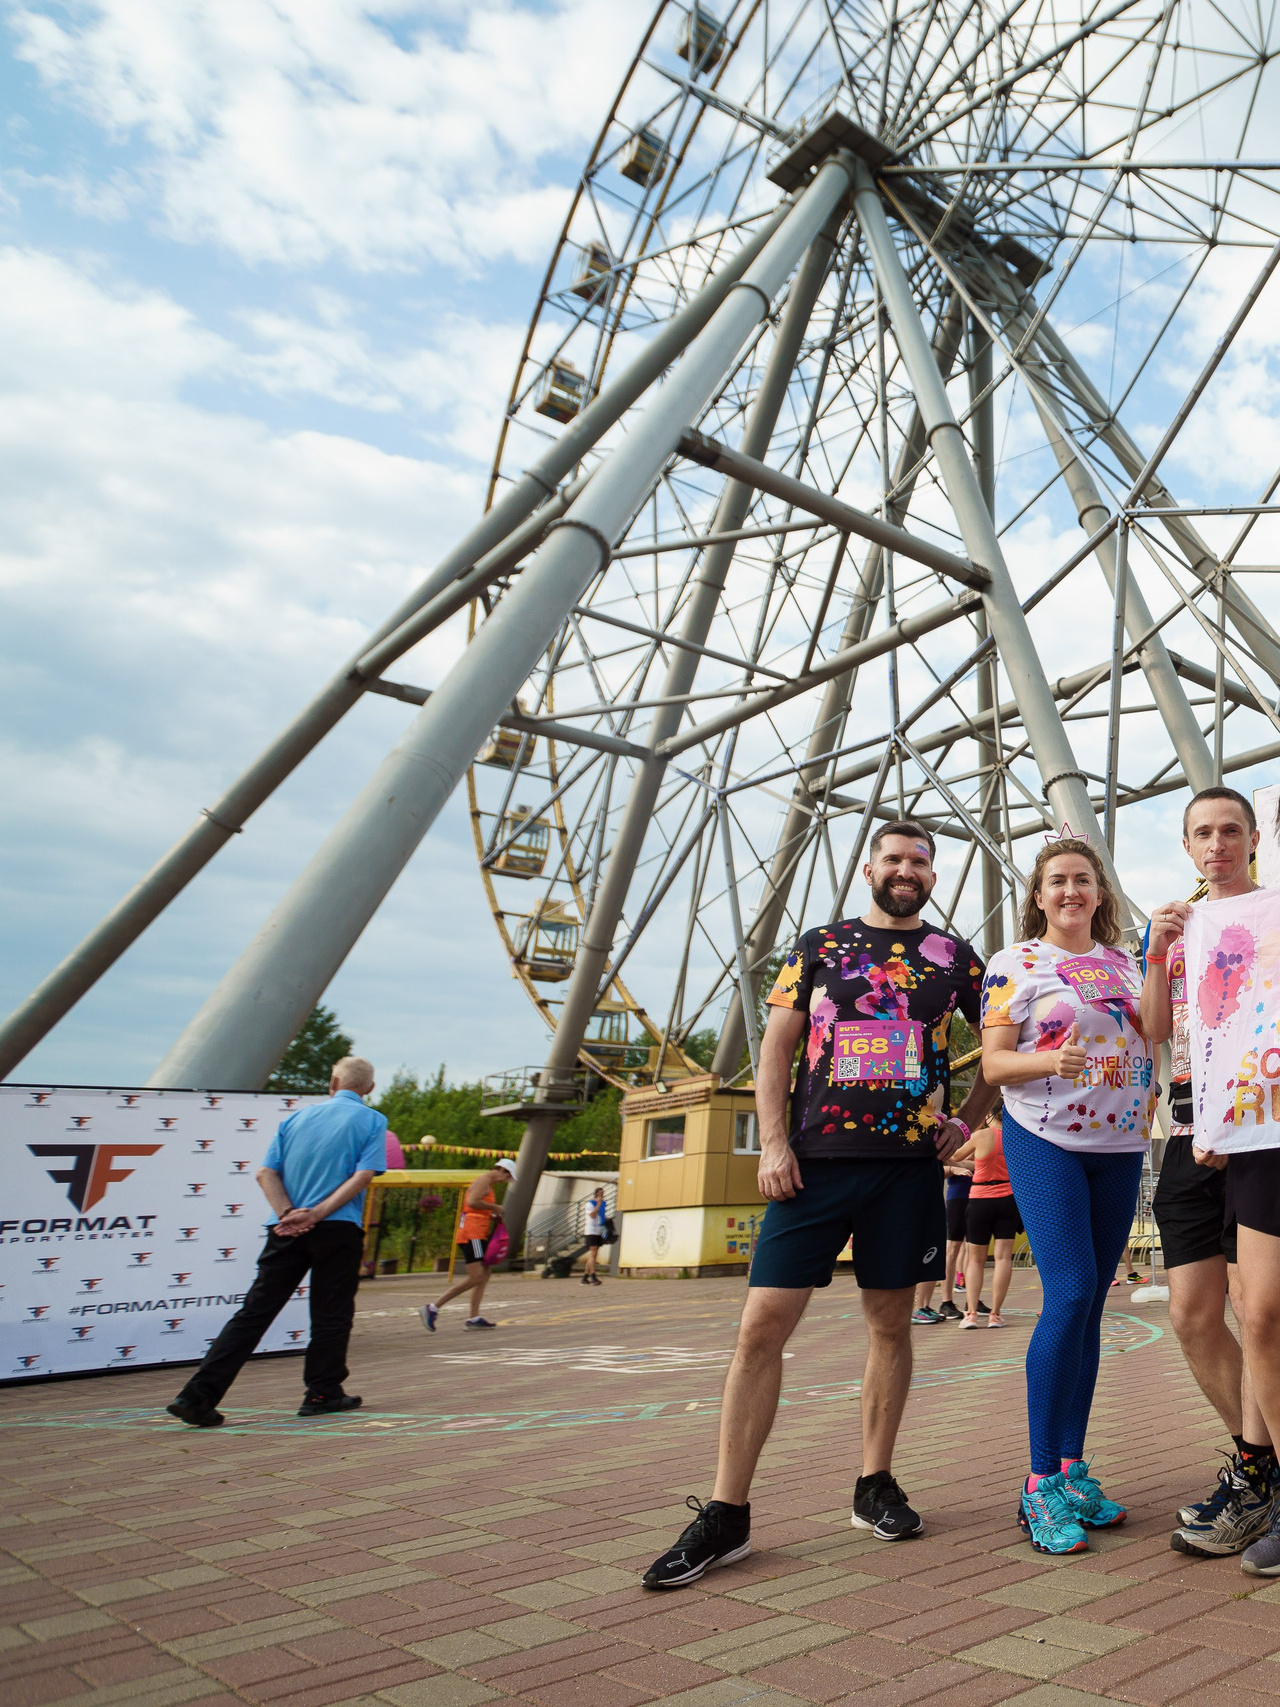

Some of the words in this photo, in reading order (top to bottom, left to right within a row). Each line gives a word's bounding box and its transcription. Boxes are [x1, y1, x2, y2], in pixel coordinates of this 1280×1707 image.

[1069, 968, 1110, 983] 190
[838, 1037, 889, 1055] 168
[1083, 1056, 1153, 1071] CHELKOO
[0, 1215, 157, 1235] FORMAT
[74, 1231, 155, 1241] CENTER
[68, 1293, 247, 1317] #FORMATFITNE
